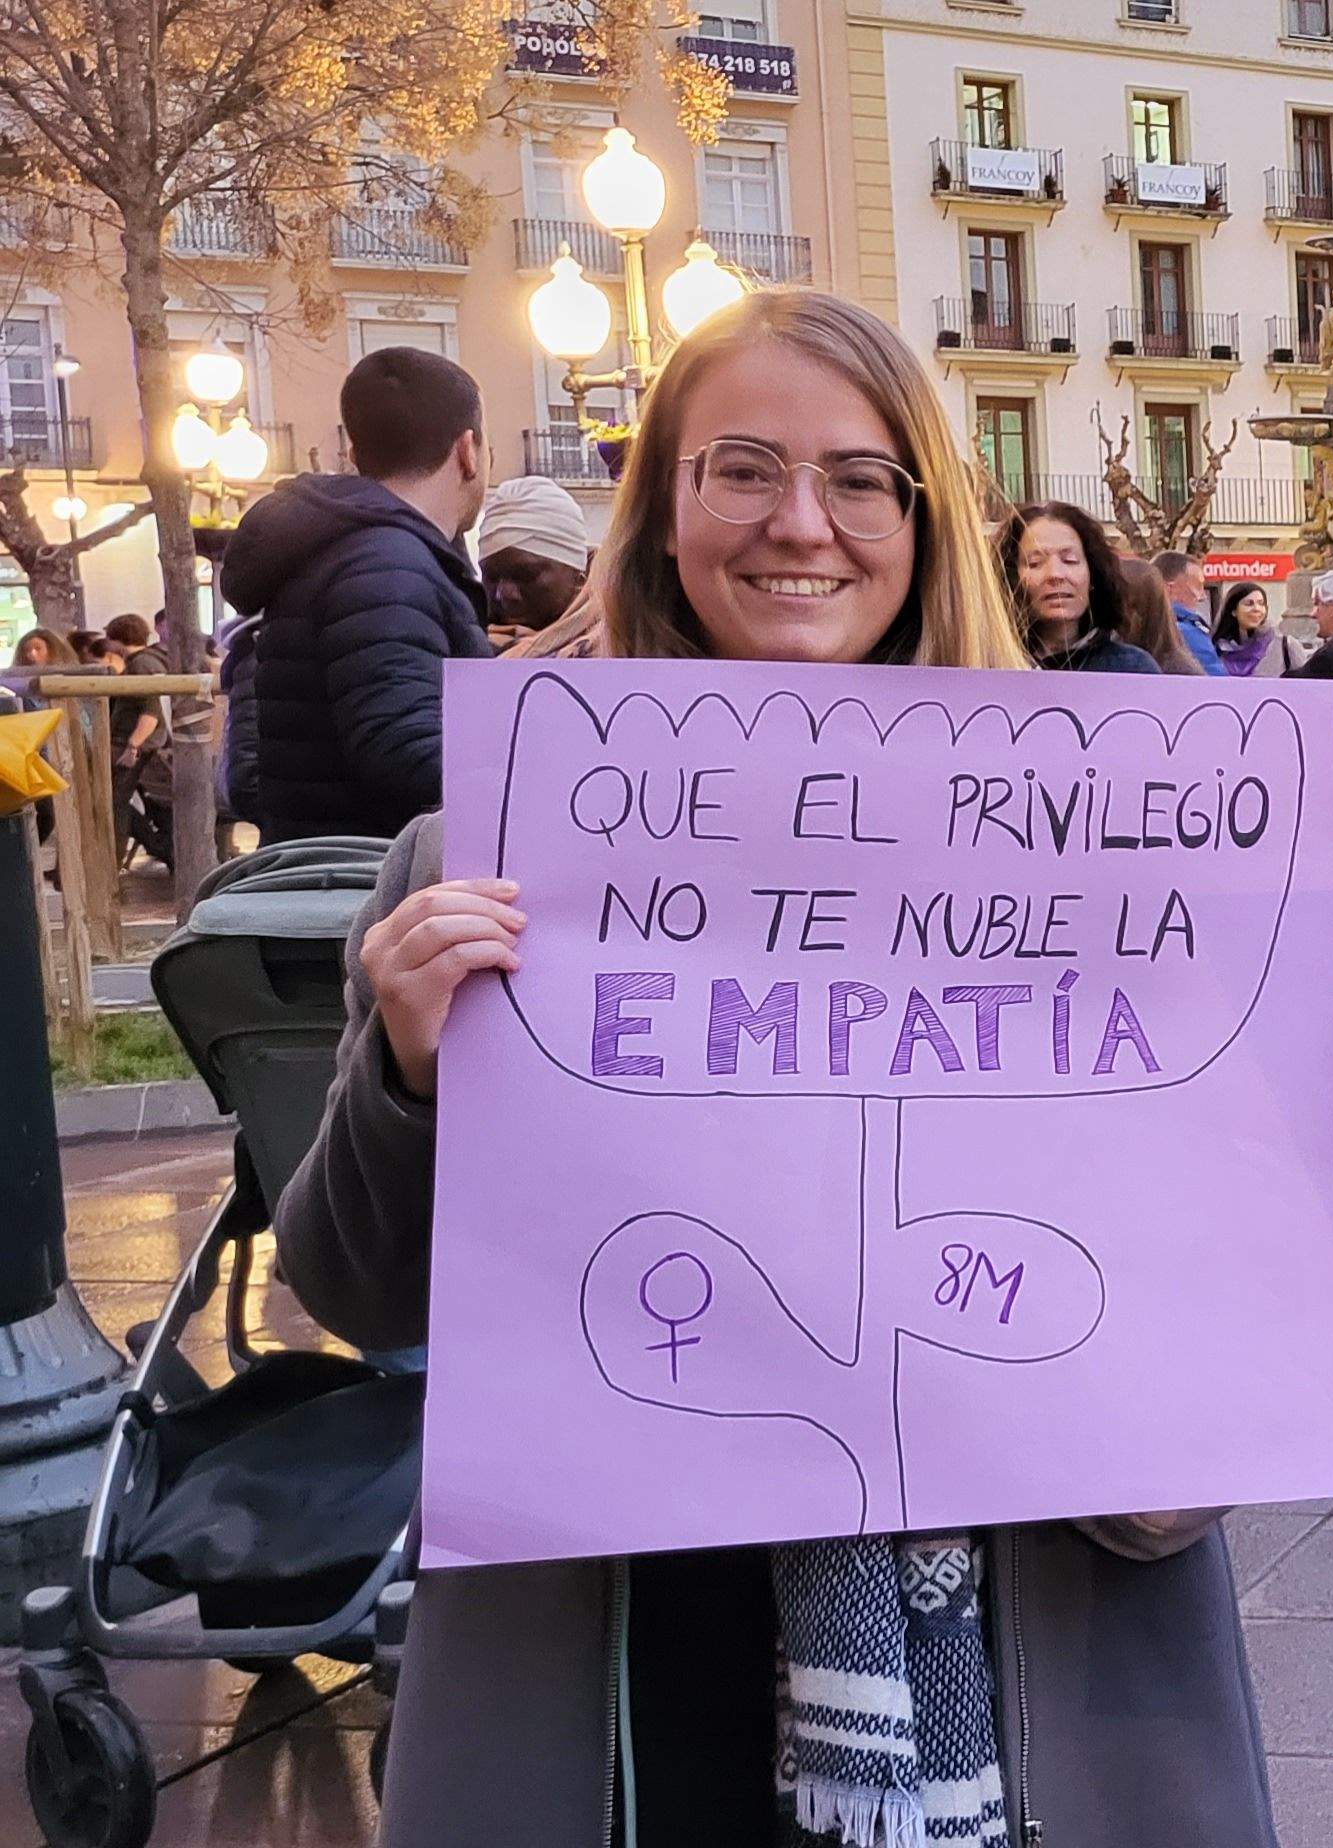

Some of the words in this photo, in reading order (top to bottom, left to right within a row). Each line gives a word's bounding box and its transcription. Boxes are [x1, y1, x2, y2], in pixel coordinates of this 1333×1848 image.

[724, 55, 756, 74] 218
[760, 59, 791, 77] 518
[971, 166, 1036, 186] FRANCOY
[1142, 181, 1201, 200] FRANCOY
[1203, 559, 1277, 577] antander
[570, 766, 738, 848] QUE
[793, 773, 899, 844] EL
[947, 767, 1270, 857] PRIVILEGIO
[598, 876, 707, 943] NO
[750, 889, 858, 953] TE
[890, 891, 1084, 960] NUBLE
[1115, 888, 1194, 962] LA
[592, 971, 1162, 1079] EMPATÍA
[934, 1244, 1024, 1324] 8M
